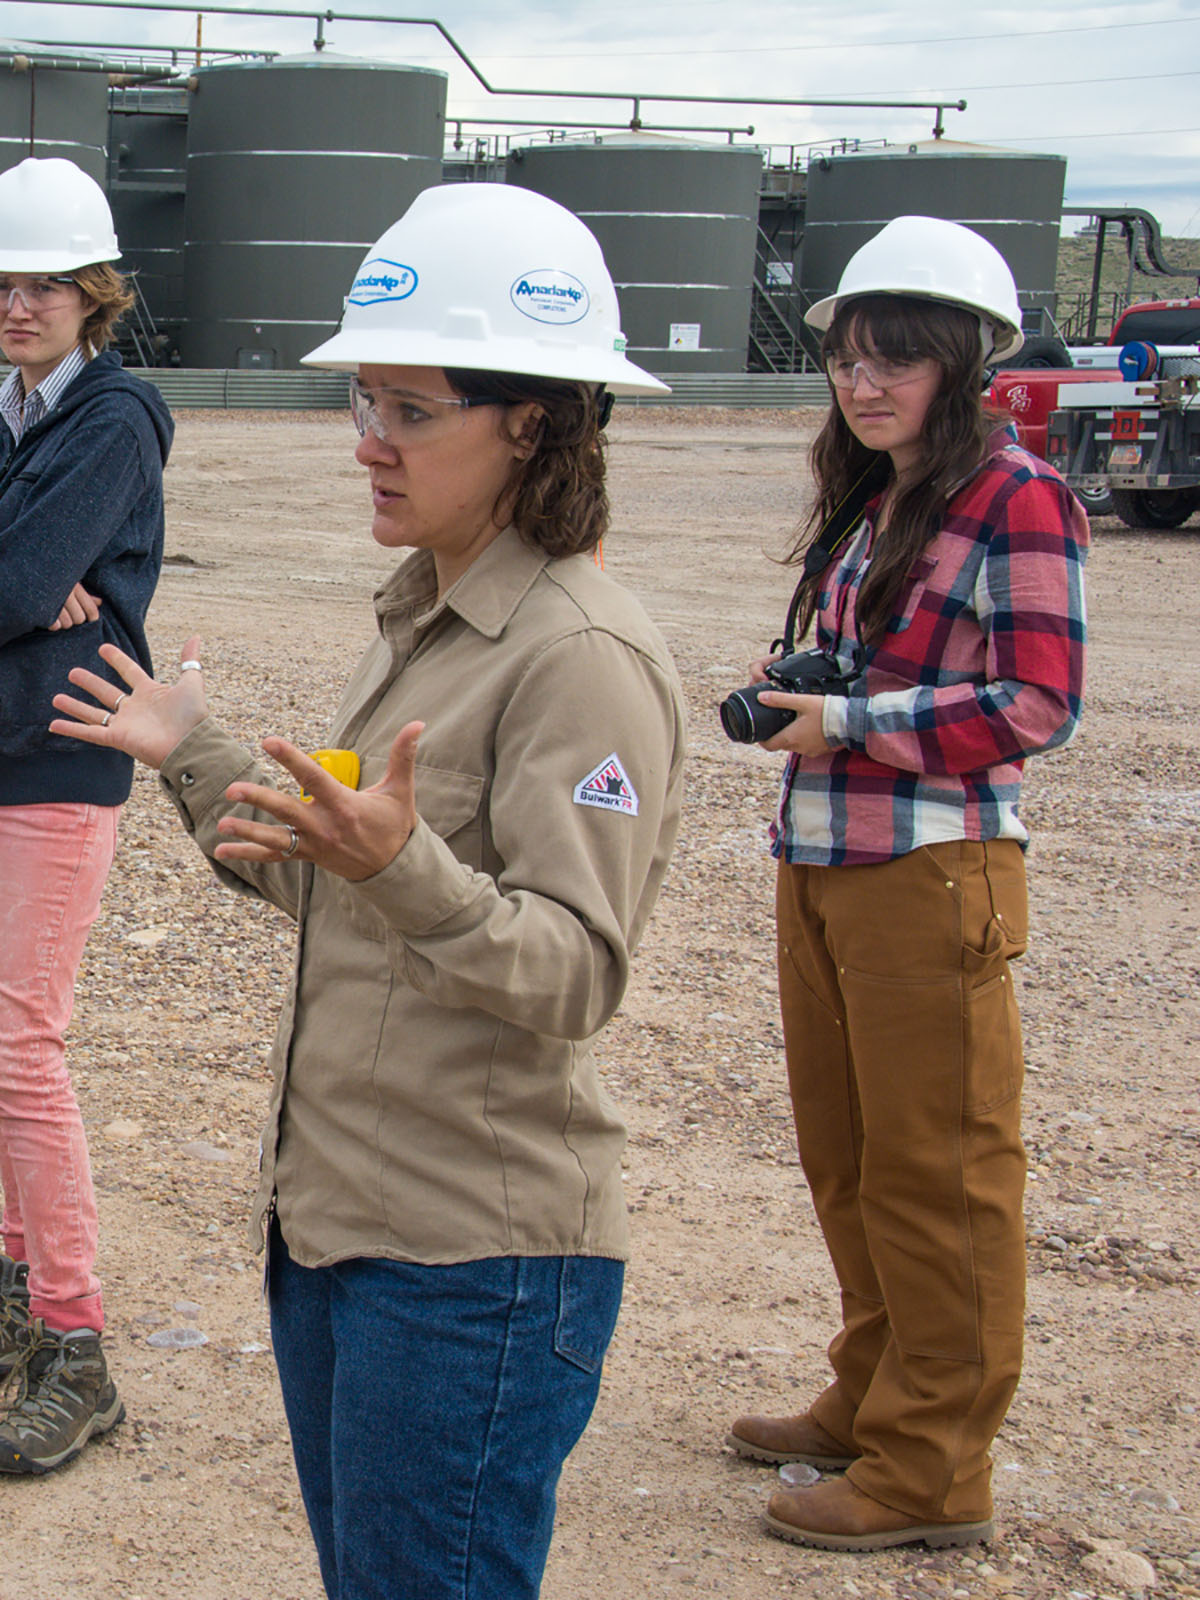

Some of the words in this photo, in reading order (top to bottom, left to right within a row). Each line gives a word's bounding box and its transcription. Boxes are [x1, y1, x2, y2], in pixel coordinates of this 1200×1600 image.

[516, 280, 581, 303] Anadarko
[580, 791, 619, 806] Bulwark
[622, 799, 632, 809] FR
